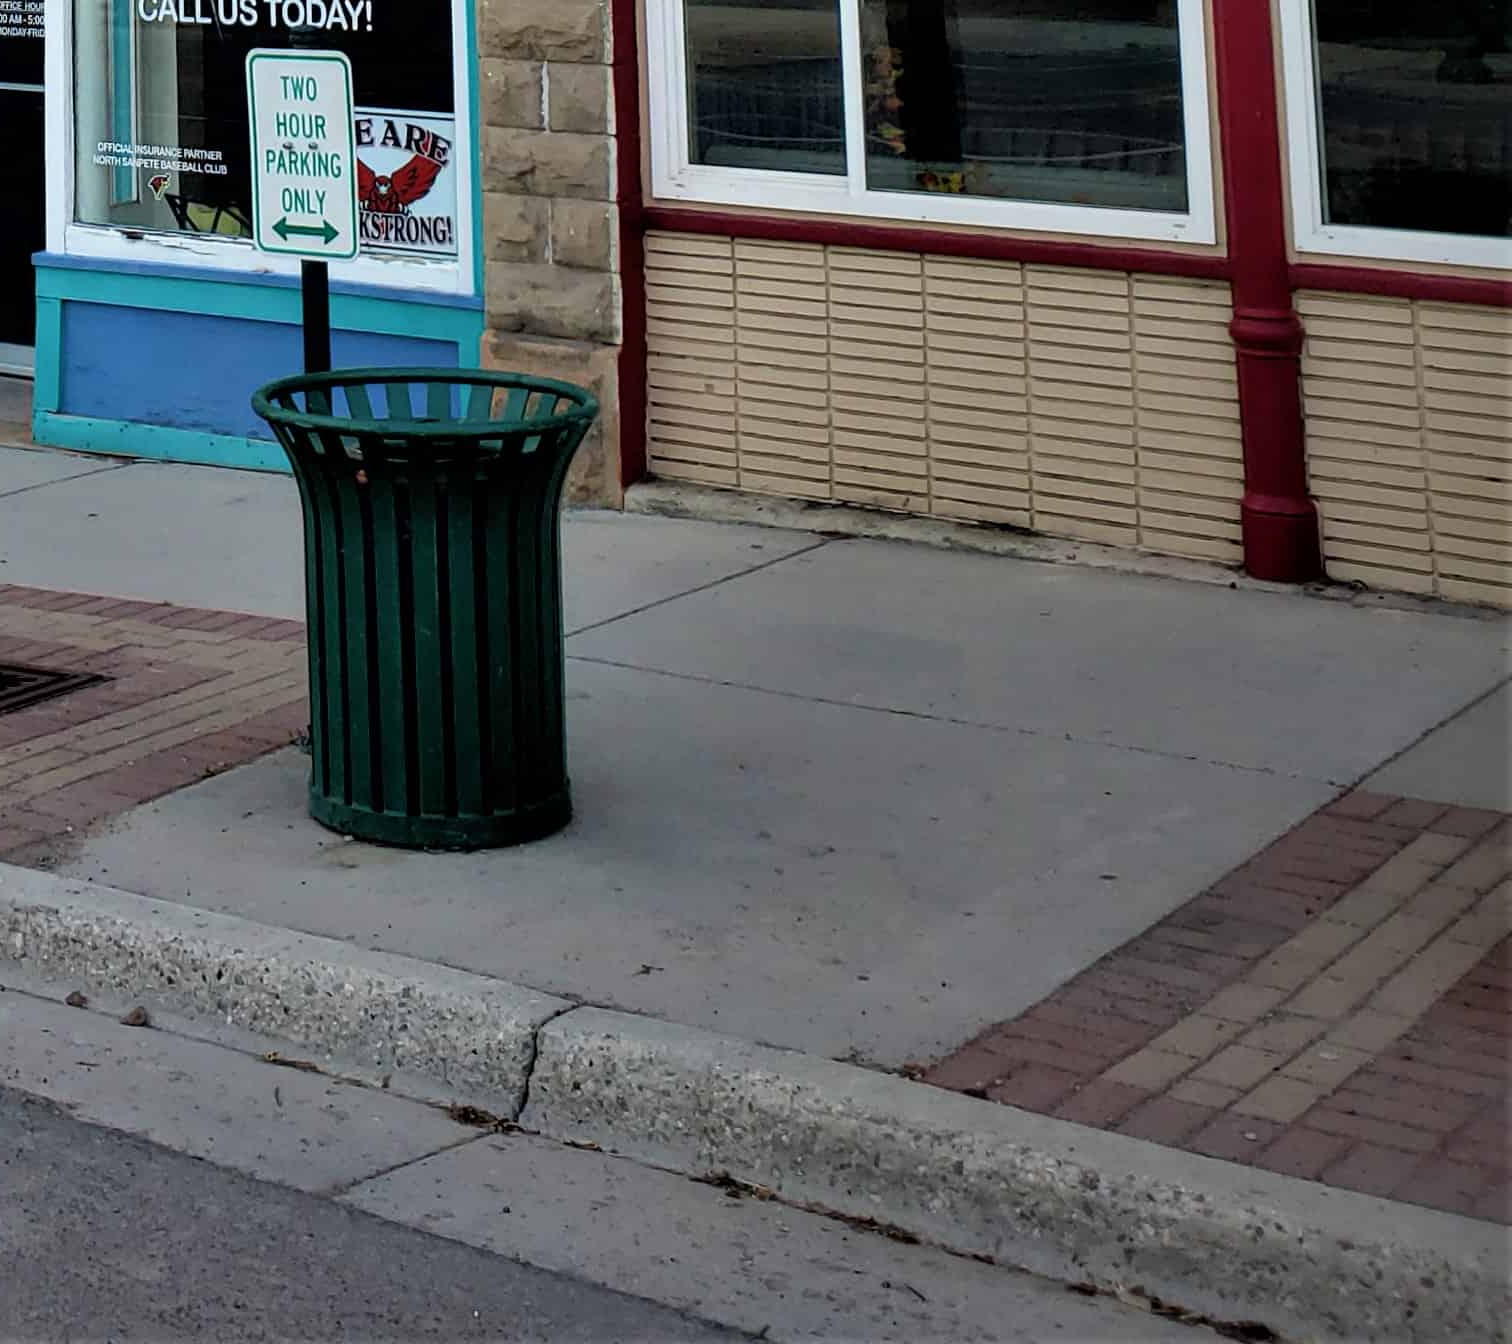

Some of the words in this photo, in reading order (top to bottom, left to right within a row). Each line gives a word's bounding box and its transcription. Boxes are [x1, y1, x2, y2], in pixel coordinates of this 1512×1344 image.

[280, 76, 317, 102] TWO
[276, 112, 326, 139] HOUR
[97, 142, 133, 154] OFFICIAL
[134, 145, 182, 158] INSURANCE
[183, 148, 222, 161] PARTNER
[380, 119, 452, 167] ARE
[93, 154, 121, 166] NORTH
[160, 159, 203, 173] BASEBALL
[204, 164, 227, 175] CLUB
[266, 149, 341, 178] PARKING
[281, 188, 326, 215] ONLY
